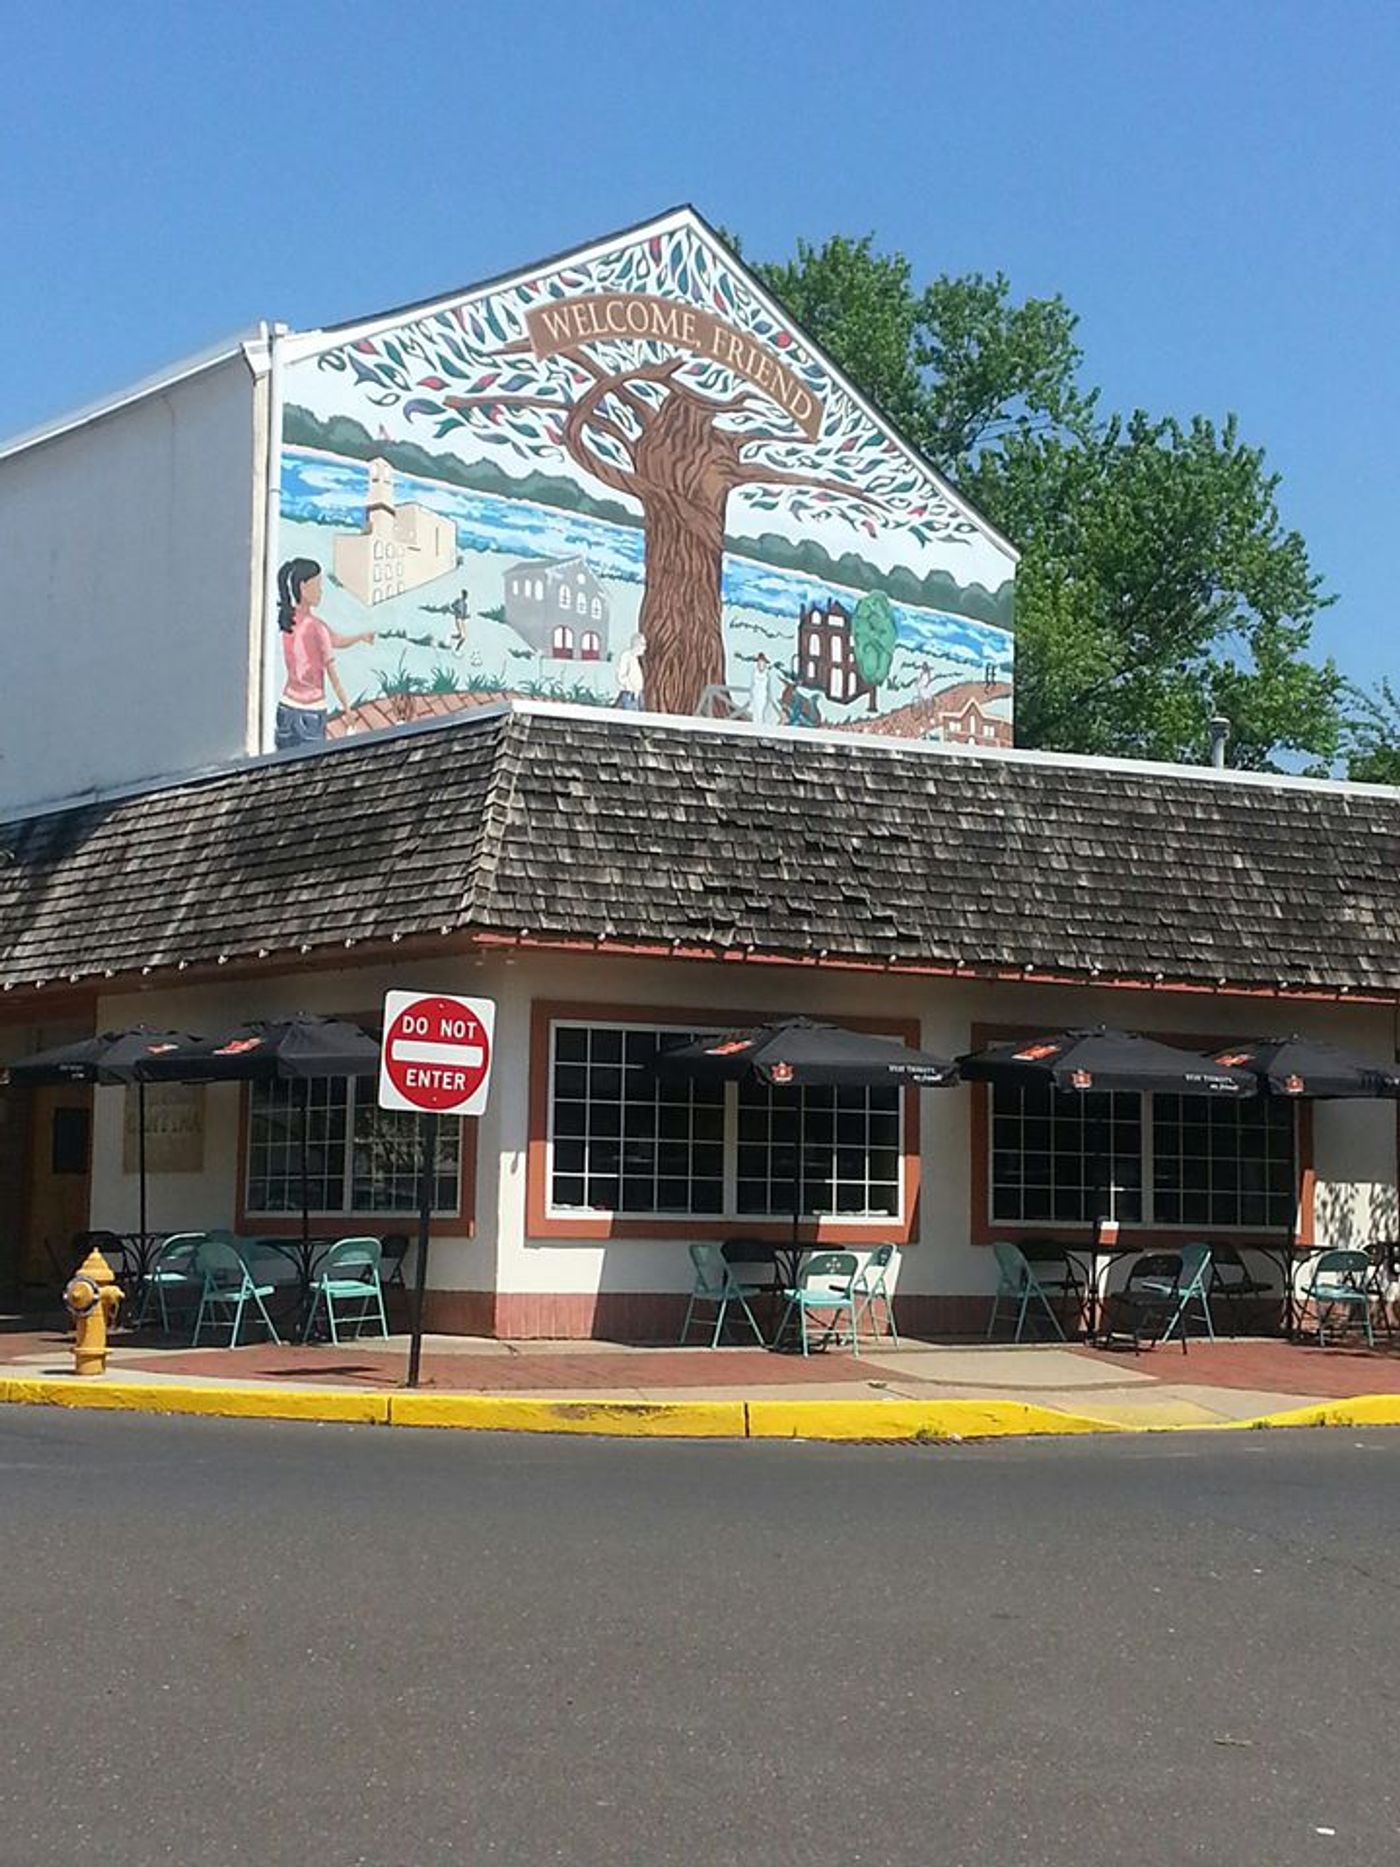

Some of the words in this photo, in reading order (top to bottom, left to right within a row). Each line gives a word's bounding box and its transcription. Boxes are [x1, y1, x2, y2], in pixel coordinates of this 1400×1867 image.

[541, 299, 702, 348] WELCOME,
[712, 325, 813, 421] FRIEND
[402, 1014, 429, 1036] DO
[440, 1018, 478, 1040] NOT
[405, 1069, 466, 1091] ENTER
